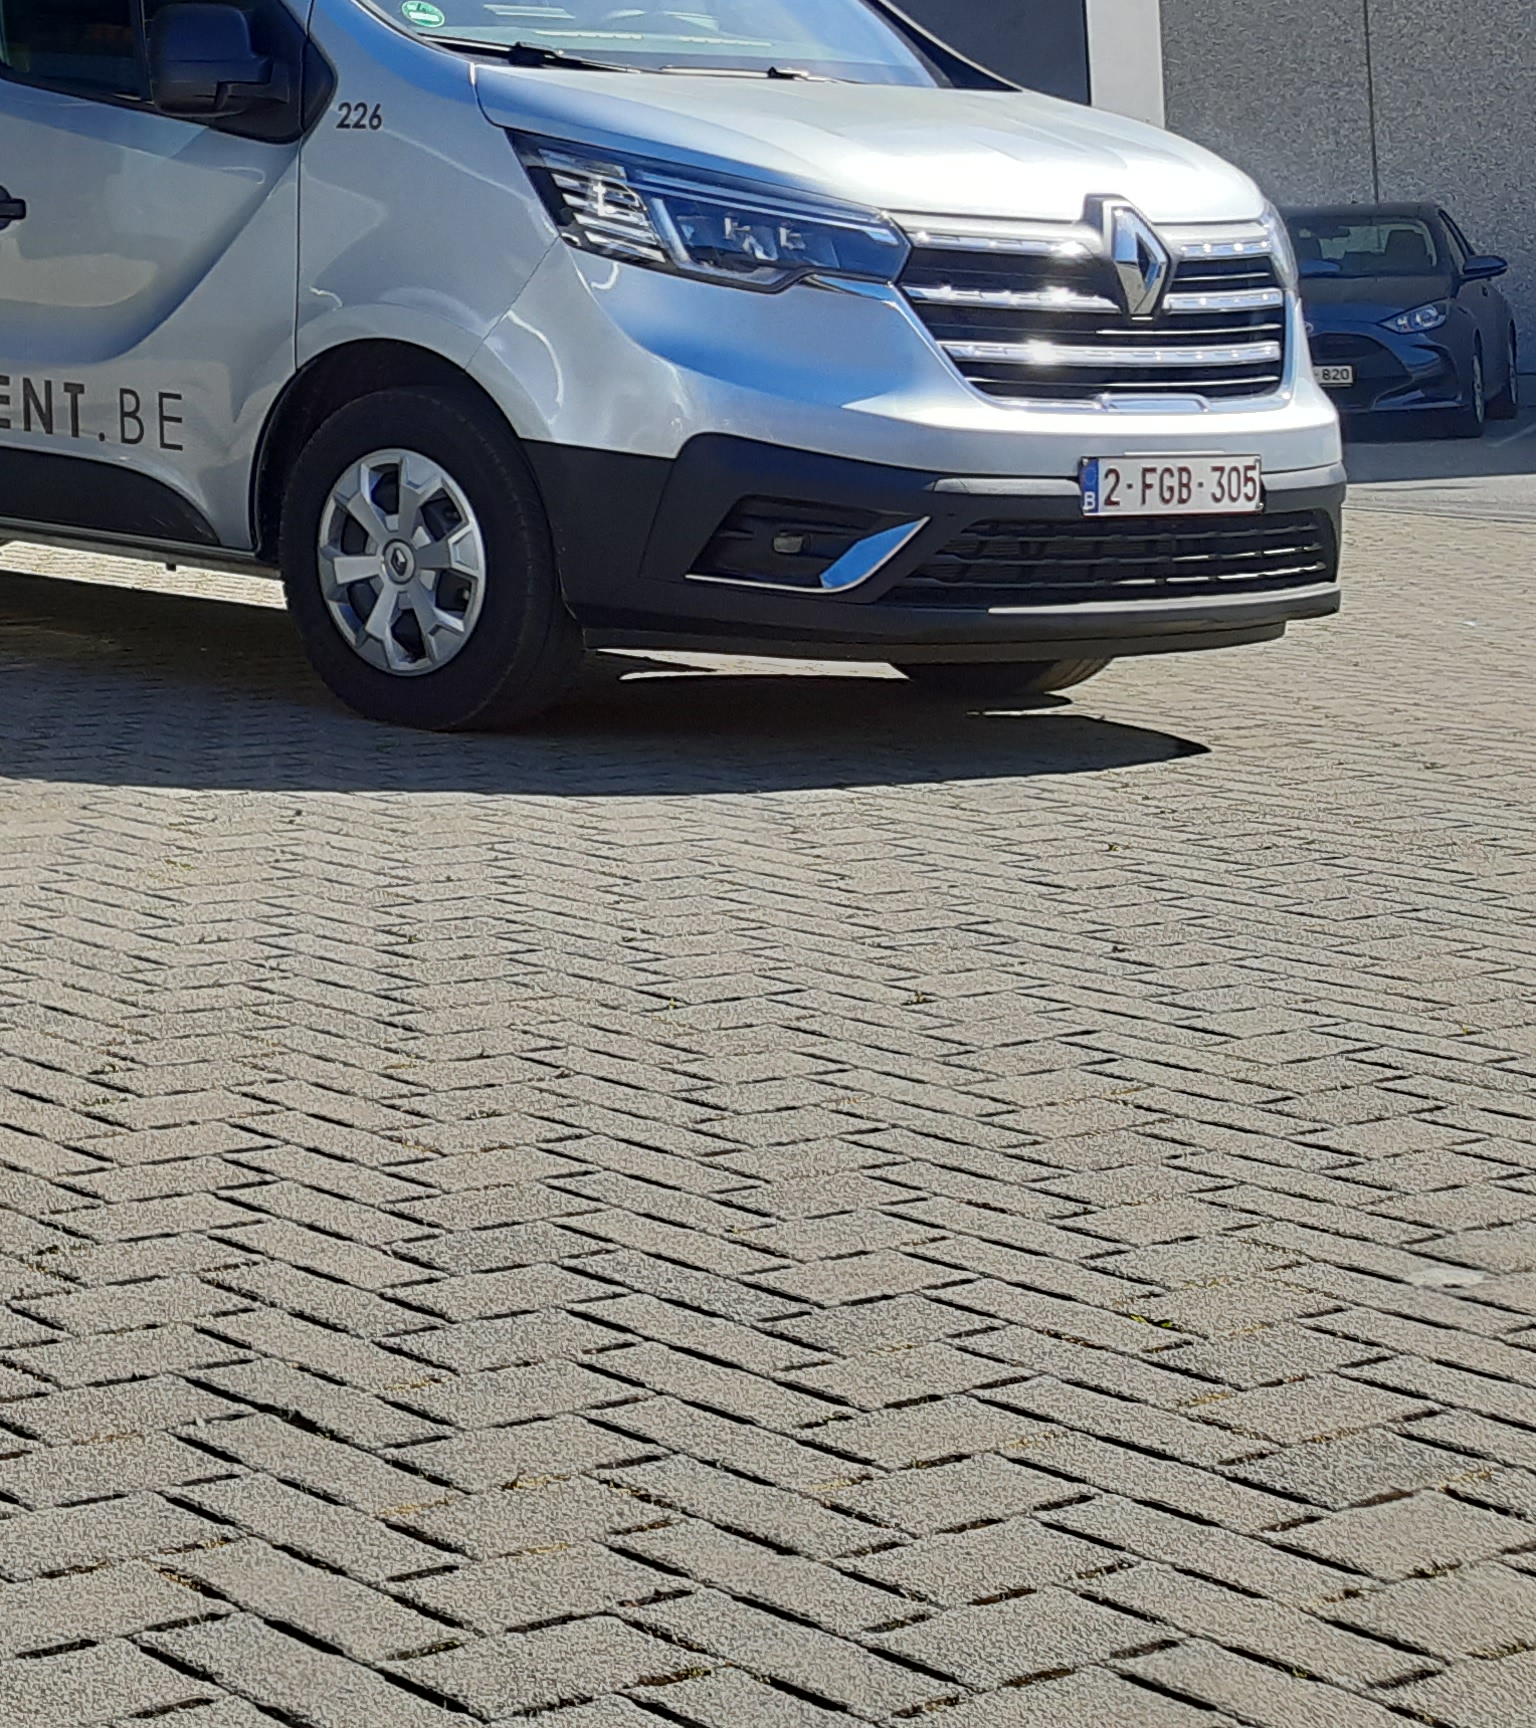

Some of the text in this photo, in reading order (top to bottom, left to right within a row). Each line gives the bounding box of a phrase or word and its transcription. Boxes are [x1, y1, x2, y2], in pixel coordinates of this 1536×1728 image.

[336, 101, 383, 131] 226
[1103, 464, 1258, 507] 2-FGB-305
[1083, 491, 1097, 511] B
